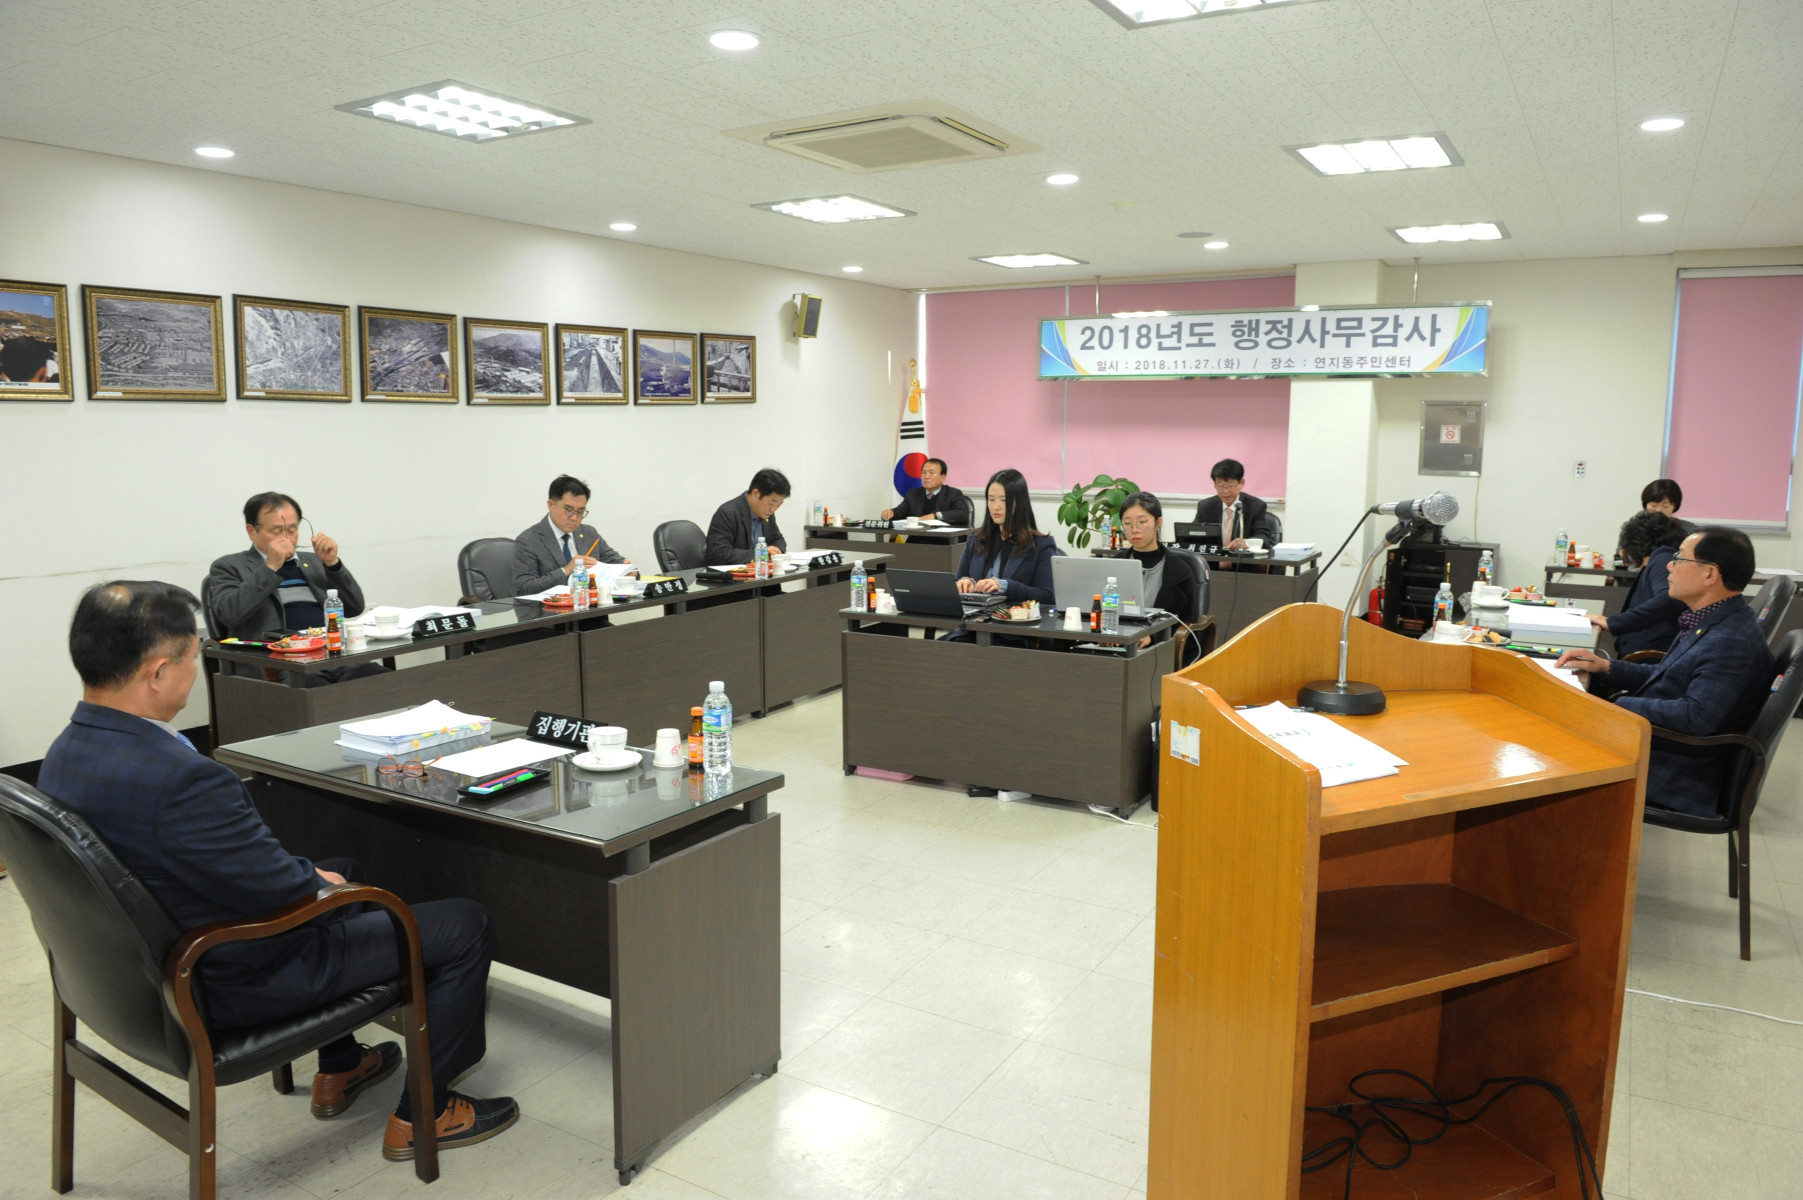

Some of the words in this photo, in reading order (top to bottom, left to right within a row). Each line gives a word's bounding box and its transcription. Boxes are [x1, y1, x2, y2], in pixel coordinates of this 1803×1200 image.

[1079, 321, 1217, 352] 2018년도
[1230, 313, 1442, 351] 행정사무감사
[1096, 360, 1119, 372] 일시
[1134, 357, 1241, 372] 2018.11.27.(화)
[1270, 357, 1296, 370] 장소
[1314, 355, 1412, 369] 연지동주민센터
